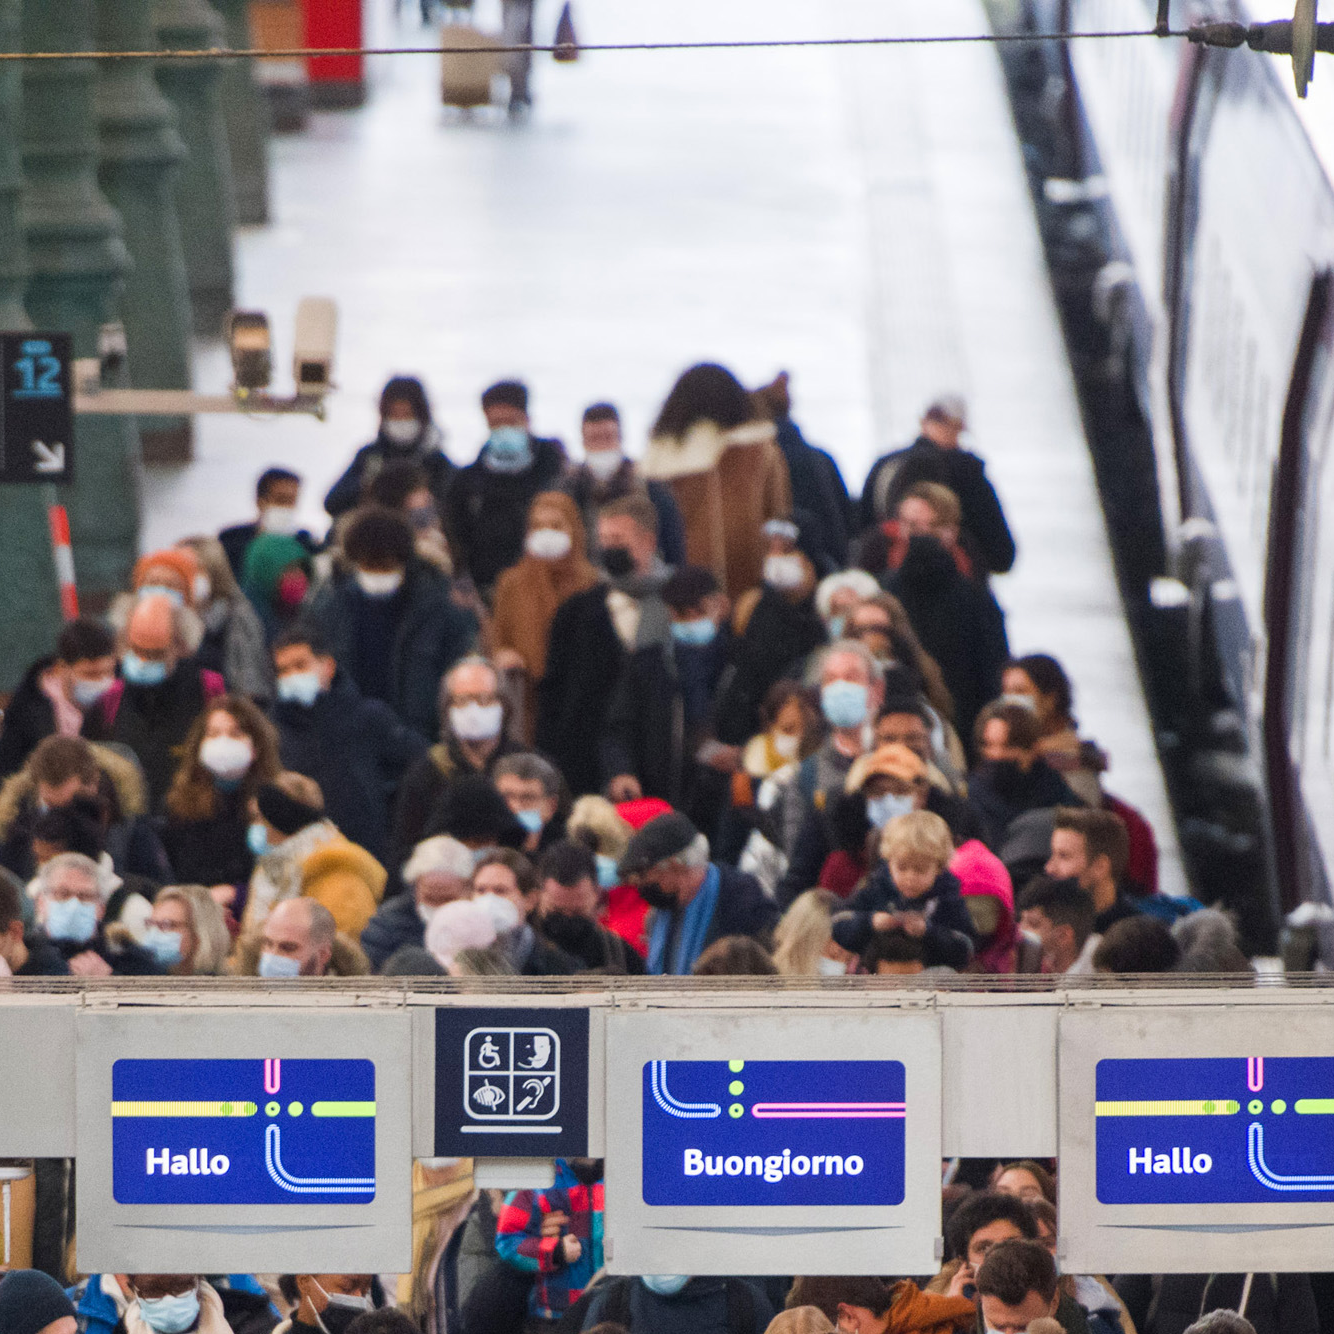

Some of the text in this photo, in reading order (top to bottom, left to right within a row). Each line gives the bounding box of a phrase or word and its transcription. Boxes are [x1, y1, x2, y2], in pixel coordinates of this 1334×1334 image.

[14, 356, 61, 391] 12
[146, 1147, 230, 1175] Hallo
[684, 1148, 864, 1183] Buongiorno
[1129, 1146, 1213, 1174] Hallo
